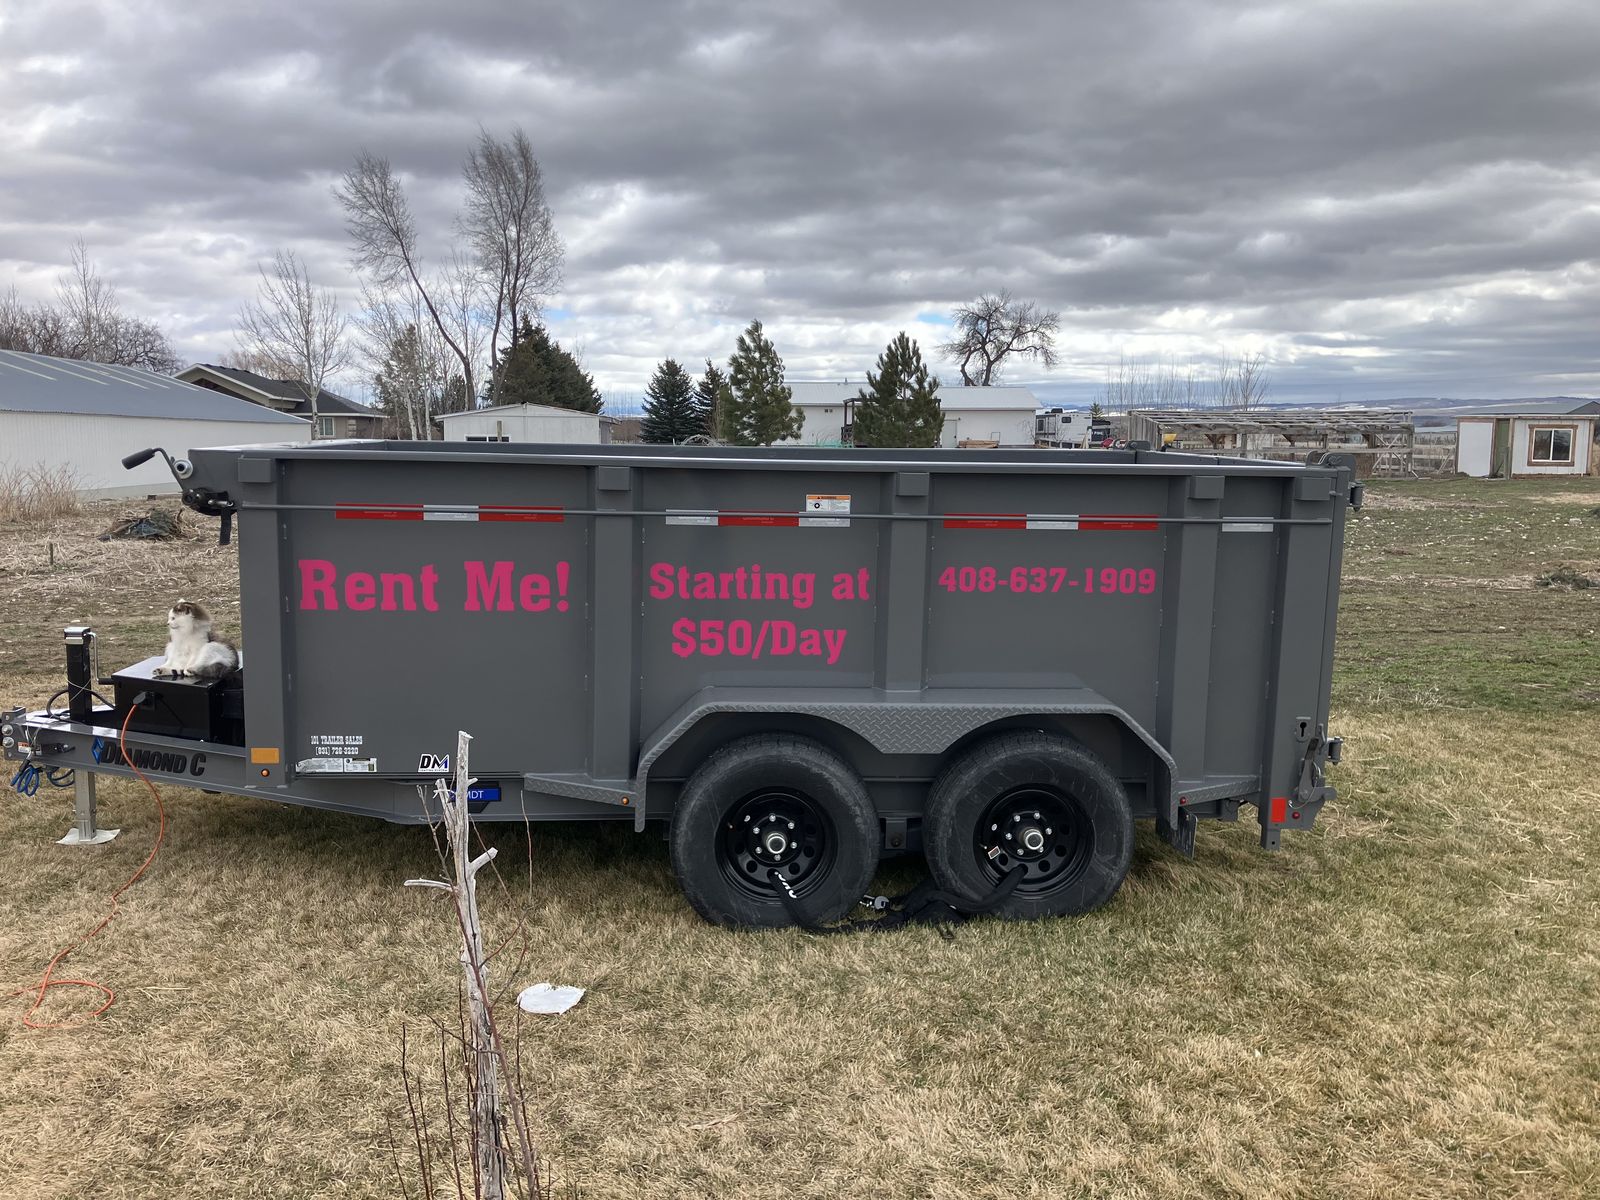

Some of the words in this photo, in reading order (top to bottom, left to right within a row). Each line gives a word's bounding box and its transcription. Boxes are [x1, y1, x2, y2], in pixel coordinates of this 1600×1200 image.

[298, 560, 439, 612] Rent
[464, 561, 570, 612] Me!
[650, 563, 816, 608] Starting
[832, 568, 870, 600] at
[939, 566, 1156, 595] 408-637-1909
[672, 617, 847, 665] $50/Day
[101, 740, 187, 774] DIAMOND
[190, 752, 207, 777] C
[320, 735, 345, 745] TRAILER
[345, 735, 363, 745] SALES
